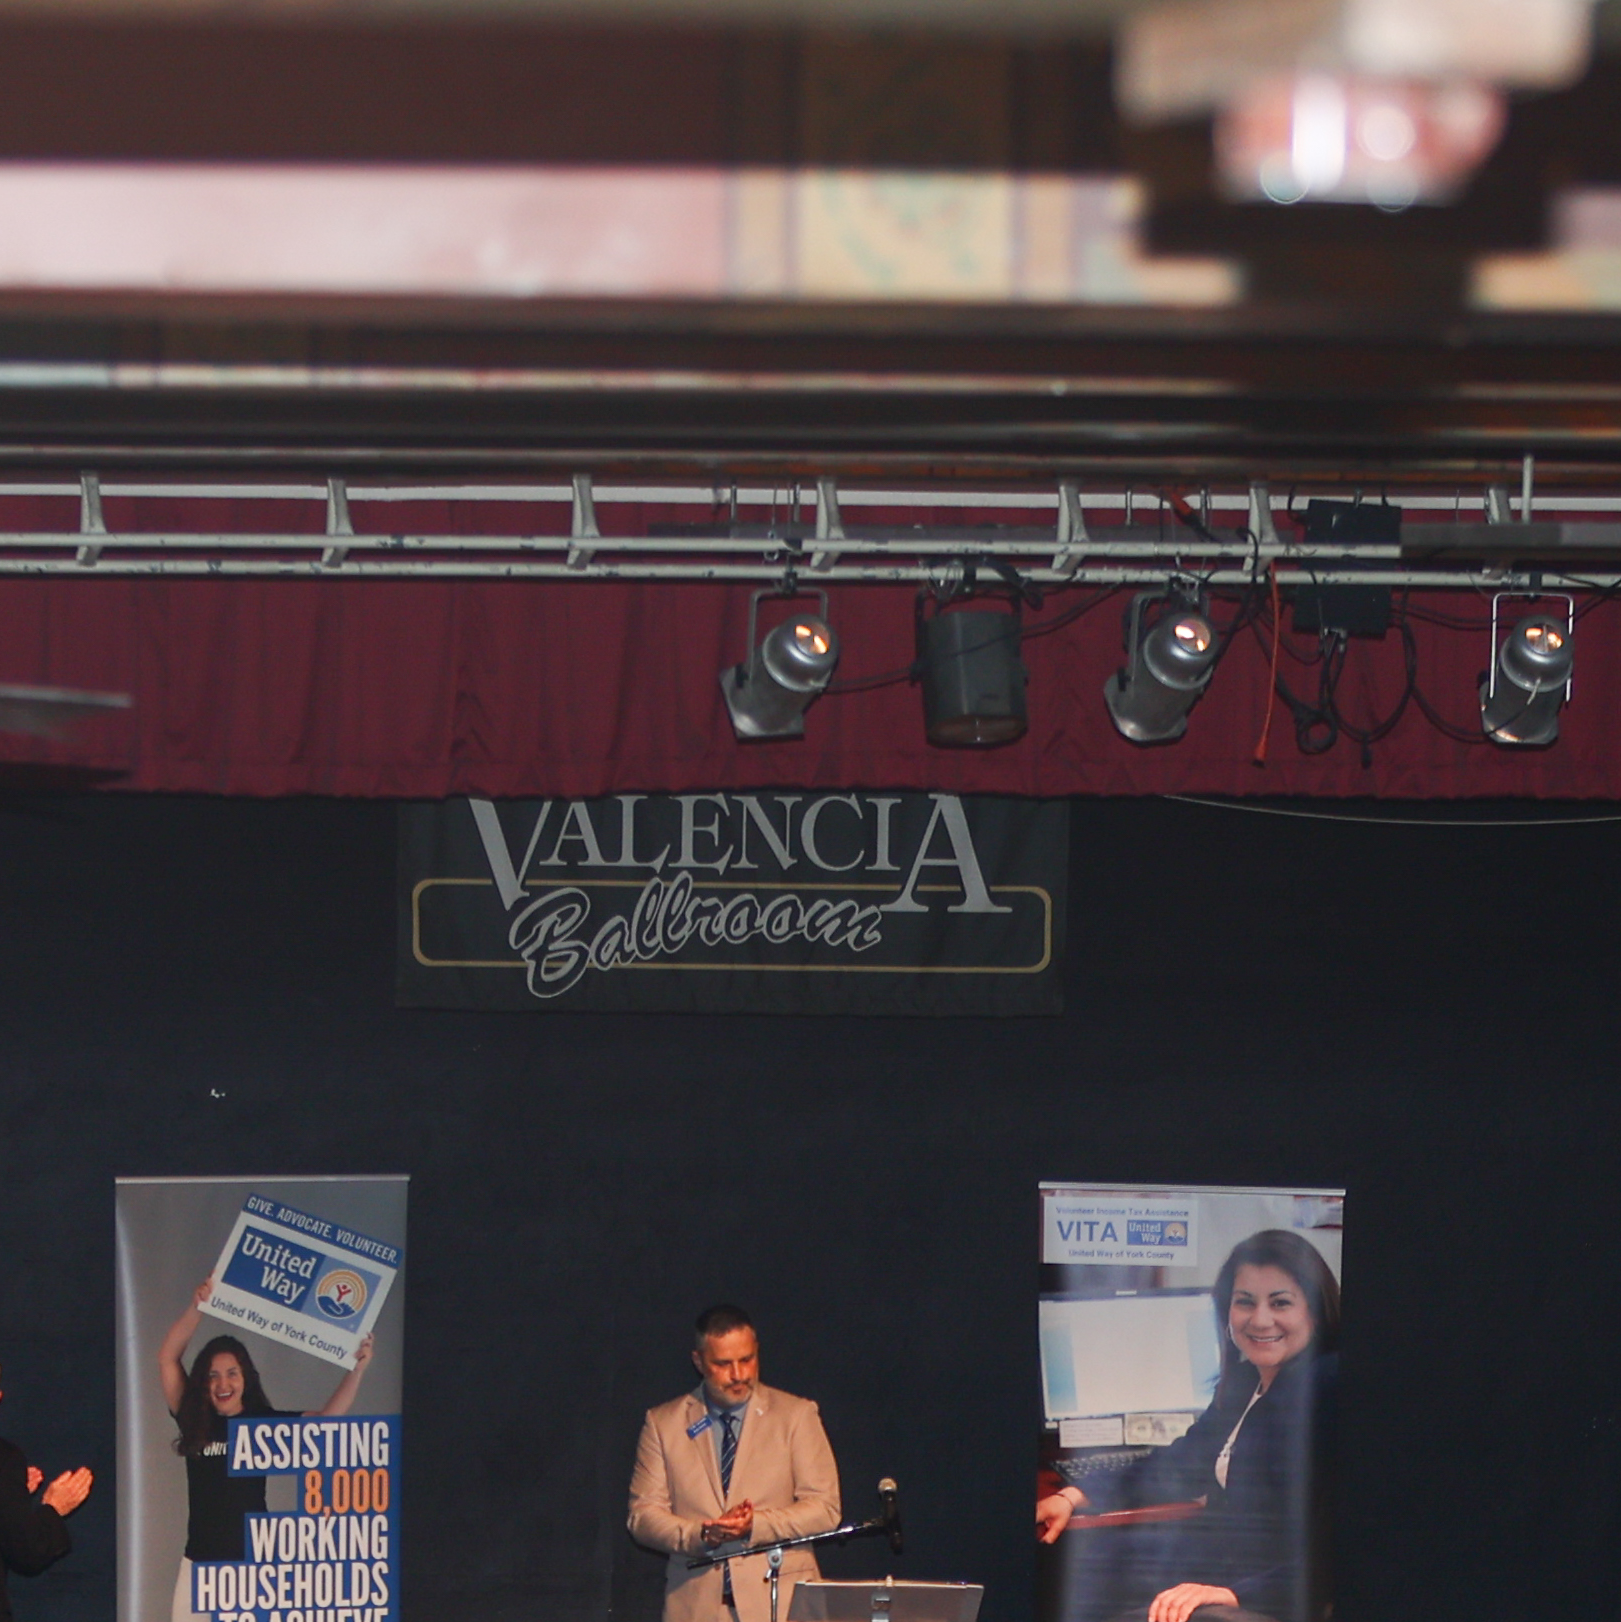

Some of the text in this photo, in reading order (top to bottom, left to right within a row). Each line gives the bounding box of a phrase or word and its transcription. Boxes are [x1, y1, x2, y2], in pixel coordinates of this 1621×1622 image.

[469, 793, 1013, 913] VALENCIA
[509, 871, 885, 999] Ballroom
[247, 1196, 398, 1264] GIVE. ADVOCATE. VOLUNTEER.
[1057, 1221, 1118, 1243] VITA
[1096, 1207, 1126, 1216] Income
[1129, 1222, 1161, 1234] United
[242, 1233, 317, 1280] United
[1068, 1250, 1095, 1258] United
[1096, 1250, 1113, 1261] Way
[1125, 1250, 1144, 1259] York
[1146, 1250, 1174, 1261] County
[1140, 1232, 1161, 1246] Way
[261, 1265, 305, 1305] Way
[211, 1296, 349, 1360] United Way of York County
[232, 1421, 390, 1470] ASSISTING
[304, 1468, 390, 1518] 8,000
[249, 1514, 390, 1563] WORKING
[197, 1561, 390, 1611] HOUSEHOLDS
